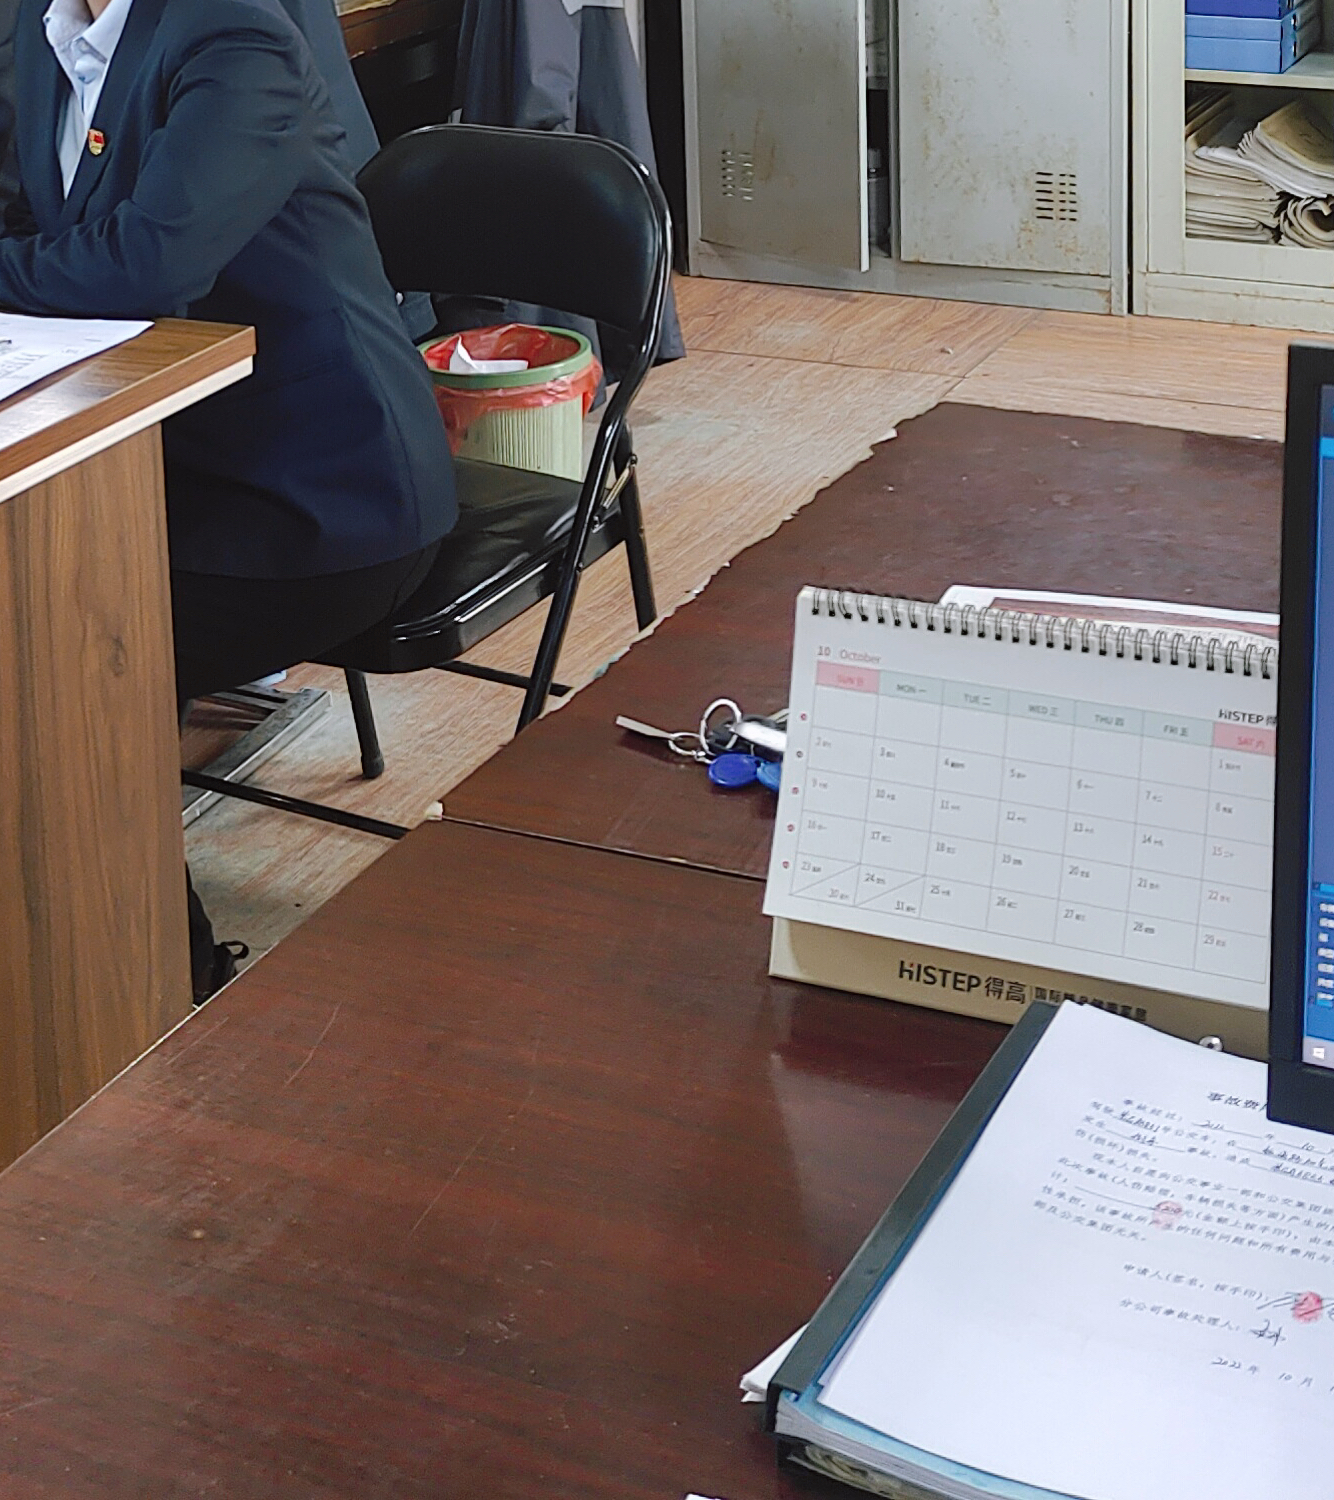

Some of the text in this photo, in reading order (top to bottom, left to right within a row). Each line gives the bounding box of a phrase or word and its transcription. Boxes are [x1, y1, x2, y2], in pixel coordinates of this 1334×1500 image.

[818, 645, 882, 664] 10 October
[896, 683, 917, 694] MON
[964, 694, 981, 704] TUE
[1028, 704, 1048, 715] WED
[1094, 714, 1113, 725] THU
[1163, 724, 1179, 735] FRI
[1237, 736, 1253, 747] SAT
[984, 975, 1027, 1006] 得高
[1207, 1090, 1268, 1112] 事故费
[1247, 1364, 1260, 1376] 年
[1278, 1372, 1293, 1383] 10
[1300, 1376, 1314, 1388] 月
